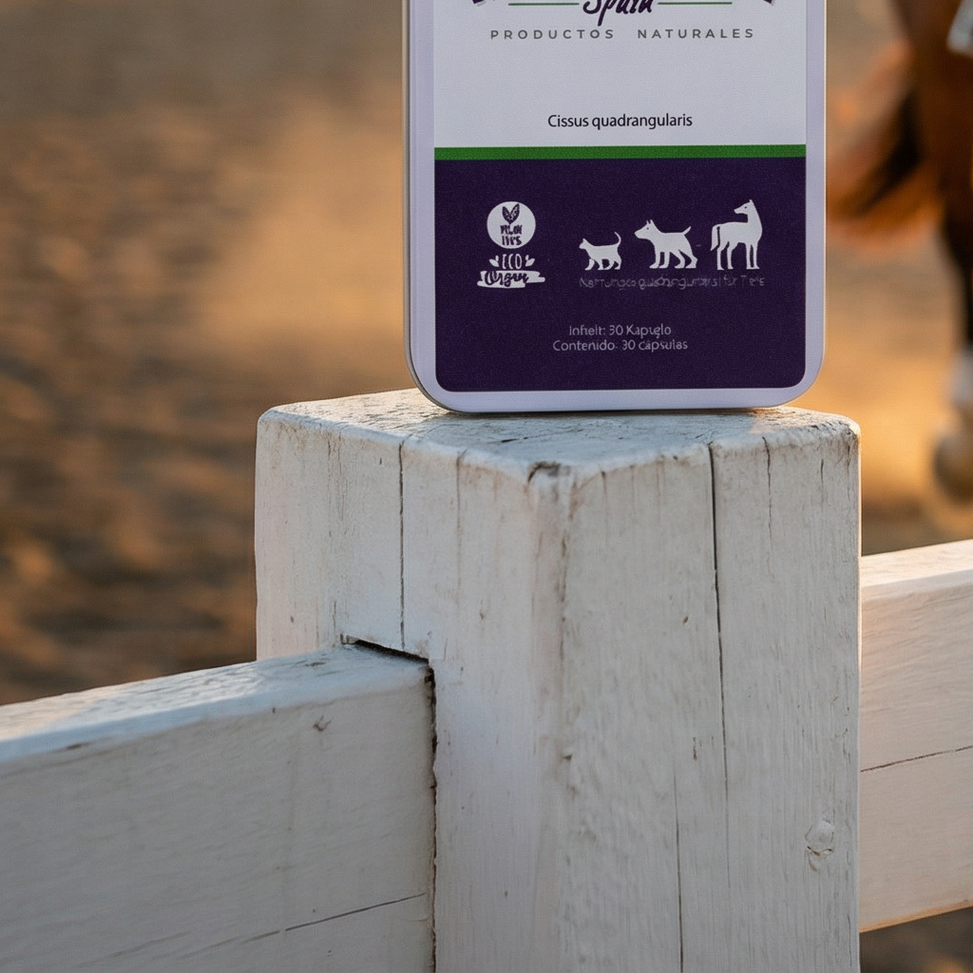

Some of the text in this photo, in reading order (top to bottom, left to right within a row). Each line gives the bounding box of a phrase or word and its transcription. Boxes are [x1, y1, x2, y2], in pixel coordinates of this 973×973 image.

[490, 28, 754, 40] PRODUCTOS NATURALES
[547, 112, 693, 131] Cissus quadrangularis
[609, 324, 624, 336] 30
[622, 339, 636, 351] 30
